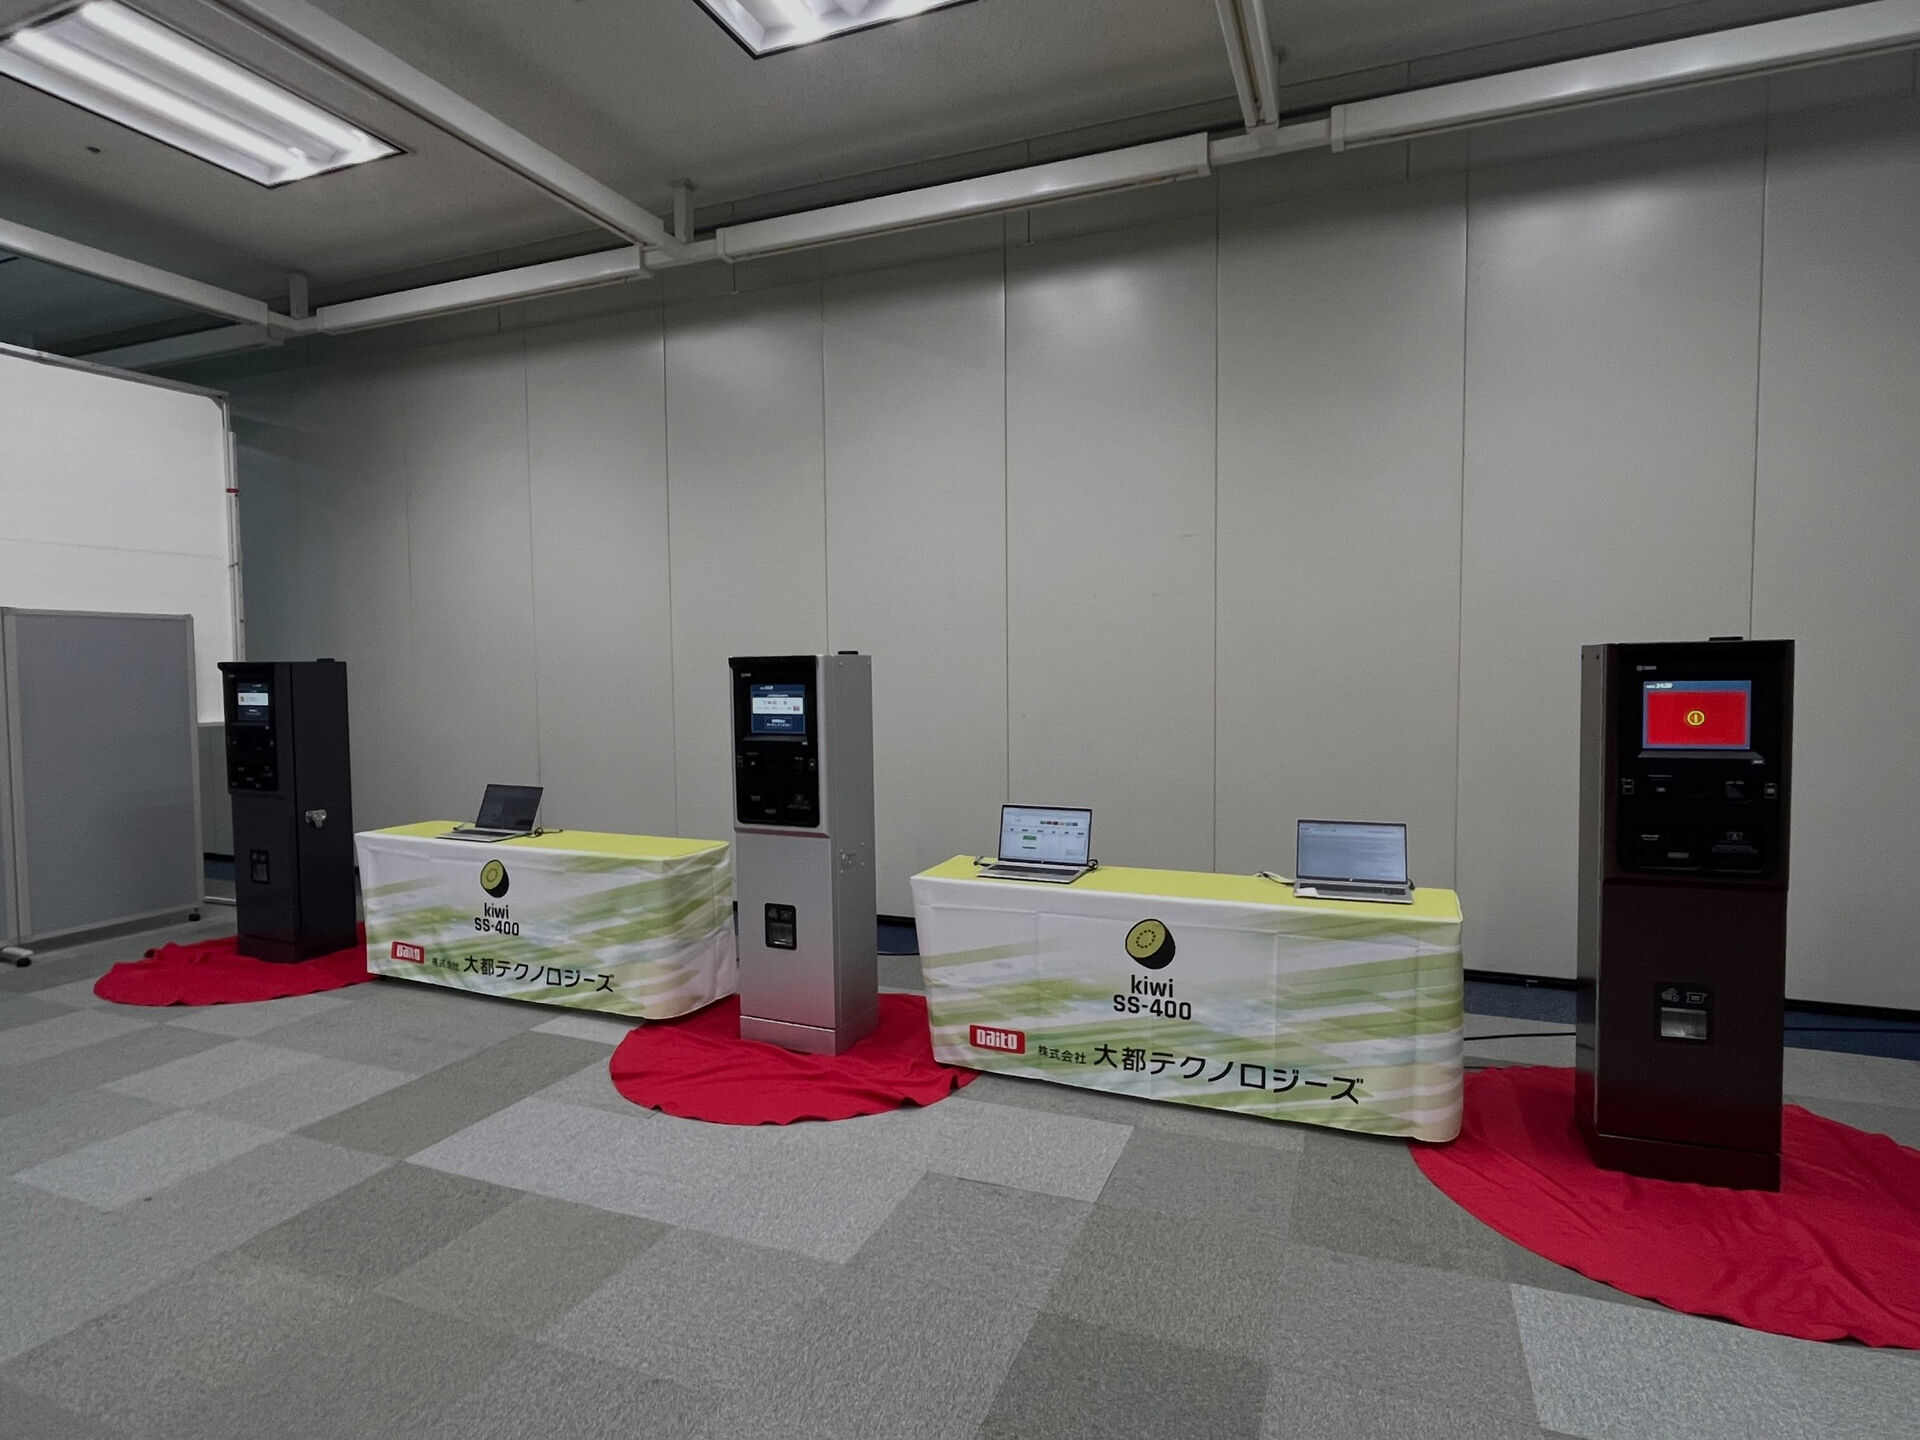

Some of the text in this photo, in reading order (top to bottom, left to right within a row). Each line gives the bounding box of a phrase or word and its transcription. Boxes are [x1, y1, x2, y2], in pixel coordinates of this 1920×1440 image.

[484, 902, 509, 919] kiwi
[474, 917, 519, 937] SS-400
[463, 956, 615, 993] 大都テクノロジーズ
[1131, 974, 1173, 998] kiwi
[1113, 994, 1191, 1020] SS-400
[976, 1029, 1018, 1050] Daito
[1038, 1043, 1364, 1105] 株式会社 大都テクノロジーズ
